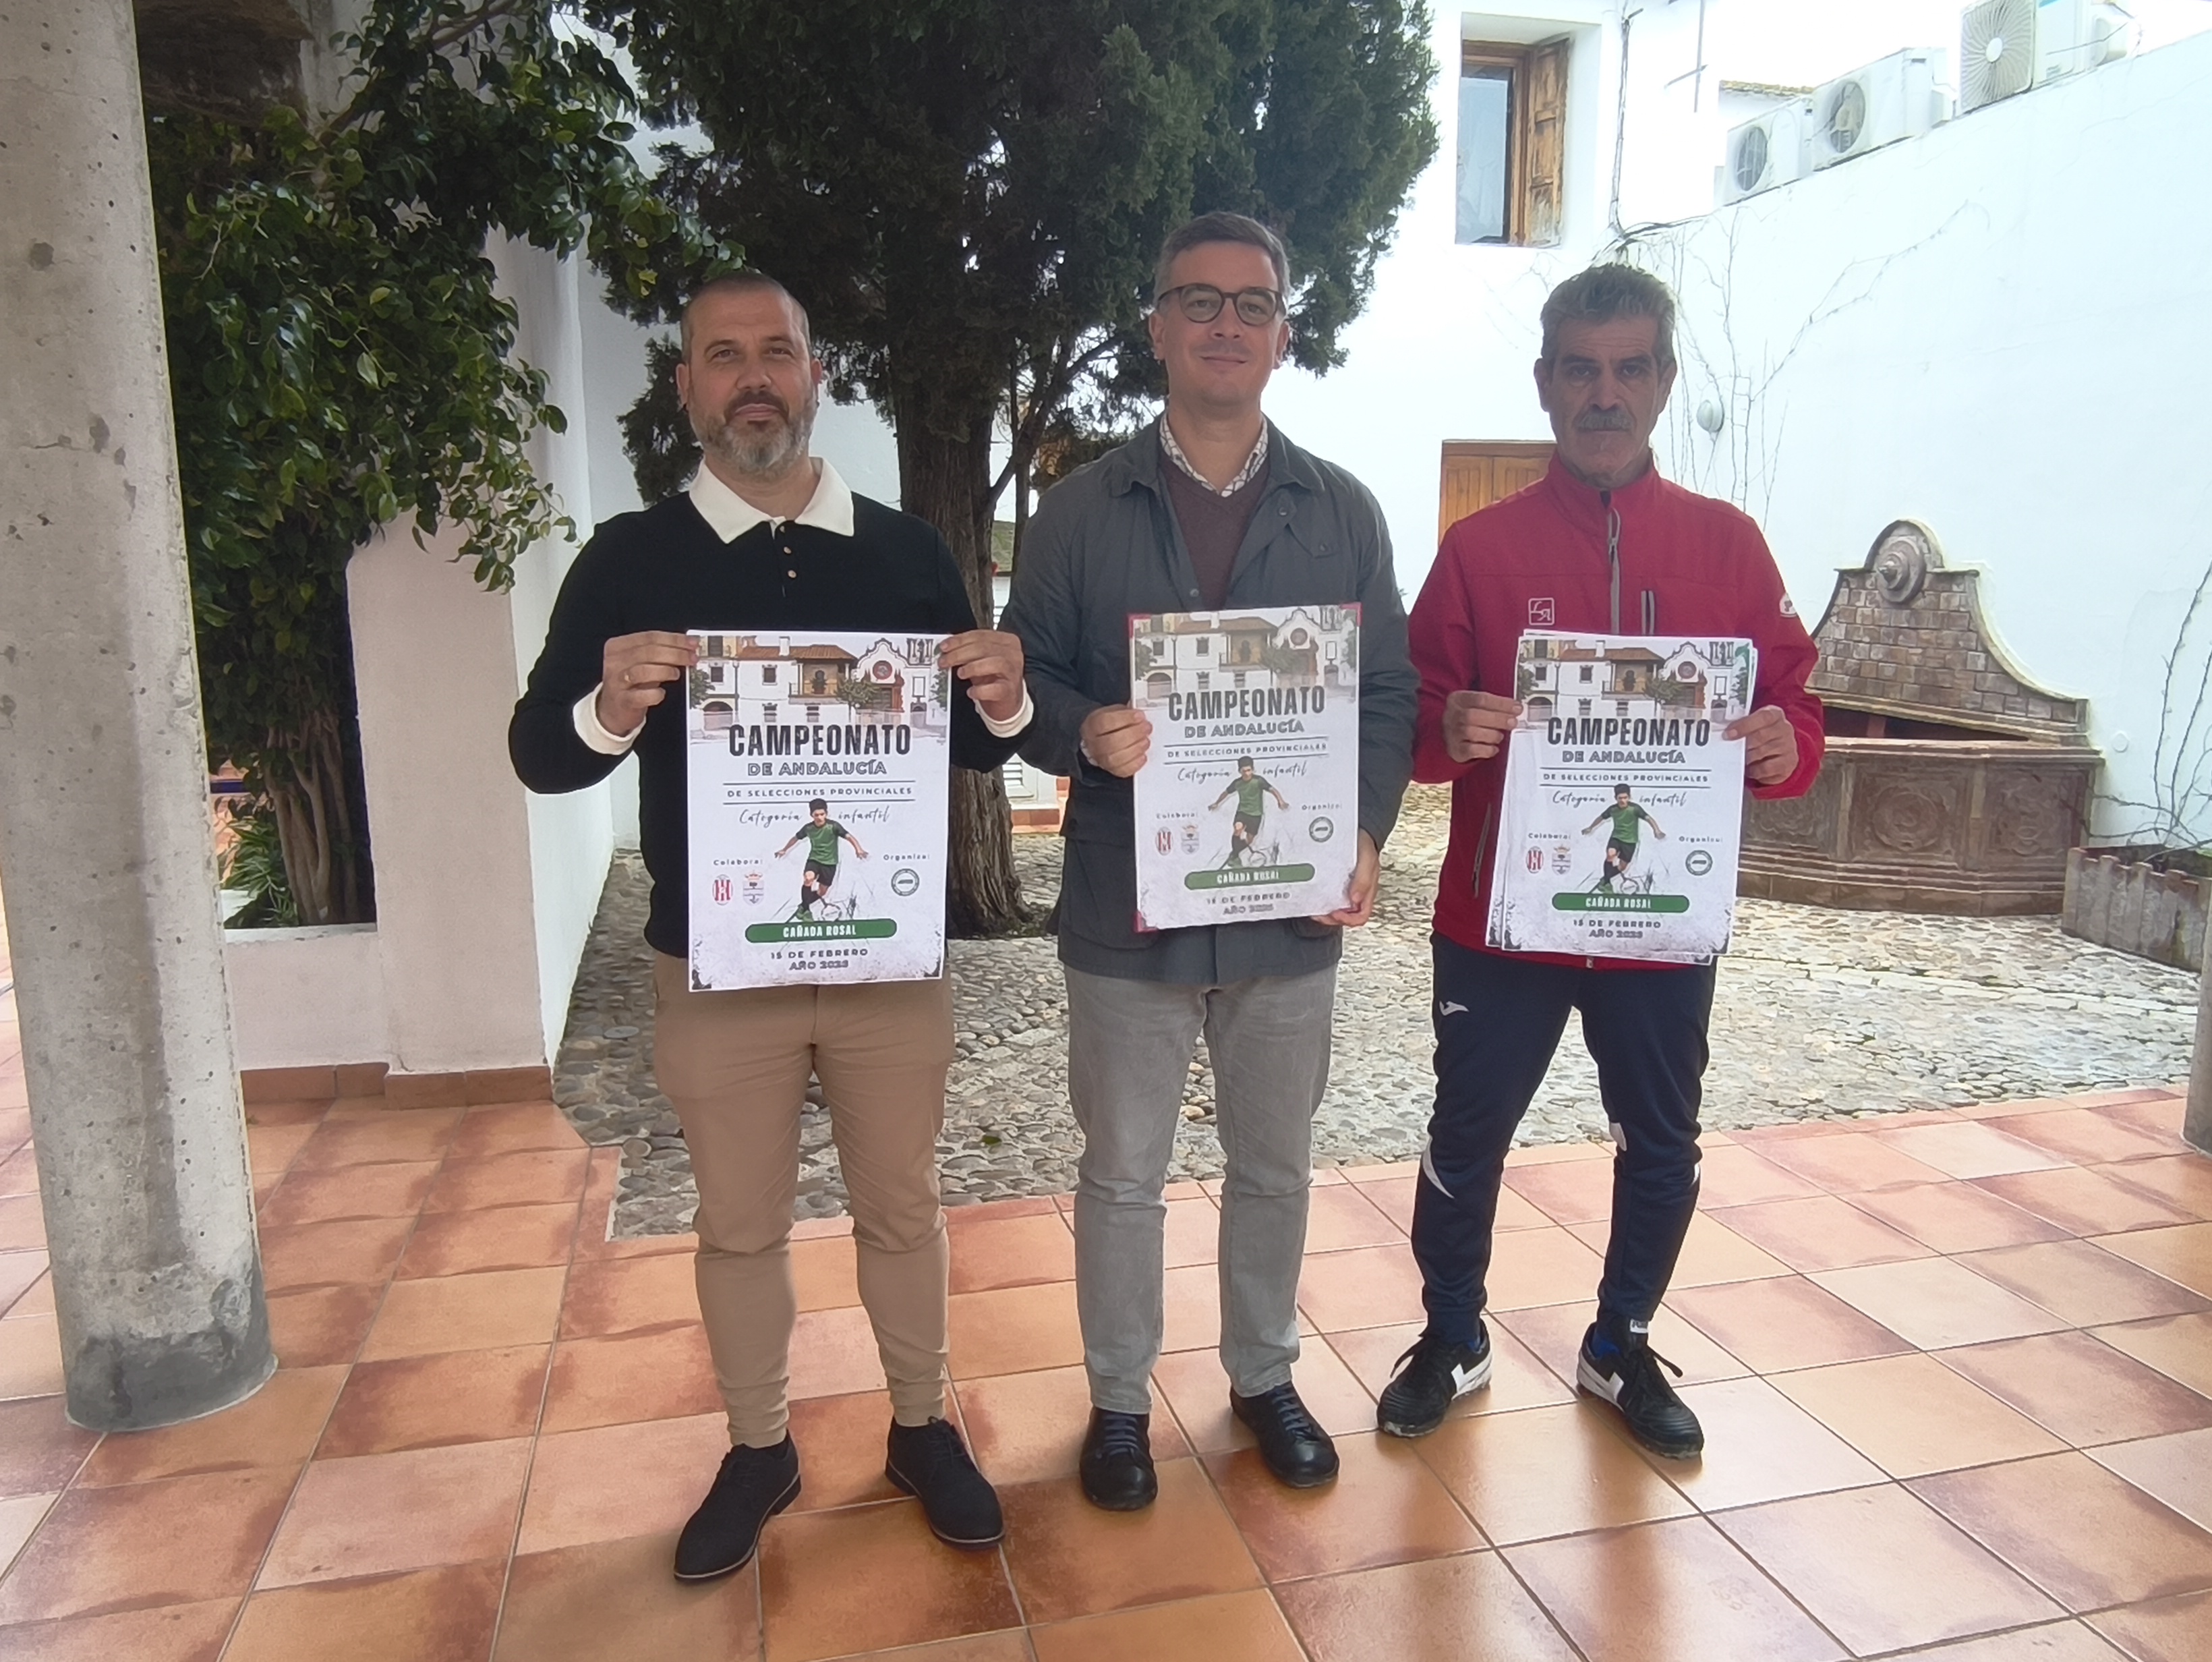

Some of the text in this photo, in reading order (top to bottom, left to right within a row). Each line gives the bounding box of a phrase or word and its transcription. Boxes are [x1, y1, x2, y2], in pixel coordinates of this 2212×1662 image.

[1168, 685, 1325, 721] CAMPEONATO
[1184, 718, 1305, 739] DE ANDALUCÍA
[1548, 717, 1710, 747] CAMPEONATO
[728, 724, 912, 757] CAMPEONATO
[1184, 747, 1252, 757] SELECCIONES
[1256, 743, 1327, 753] PROVINCIALES
[1562, 749, 1685, 764] DE ANDALUCÍA
[747, 759, 887, 776] DE ANDALUCÍA
[748, 789, 825, 797] SELECCIONES
[830, 787, 912, 795] PROVINCIALES
[1639, 791, 1687, 807] infantil
[838, 805, 890, 824] infantil
[1217, 871, 1251, 884] CAÑADA
[1585, 896, 1651, 909] CAÑADA ROSAL
[1223, 905, 1246, 915] AÑO
[1608, 920, 1661, 928] FEBRERO
[783, 925, 856, 938] CAÑADA ROSAL
[1589, 929, 1614, 938] AÑO
[810, 948, 868, 958] FEBRERO
[788, 961, 816, 971] AÑO
